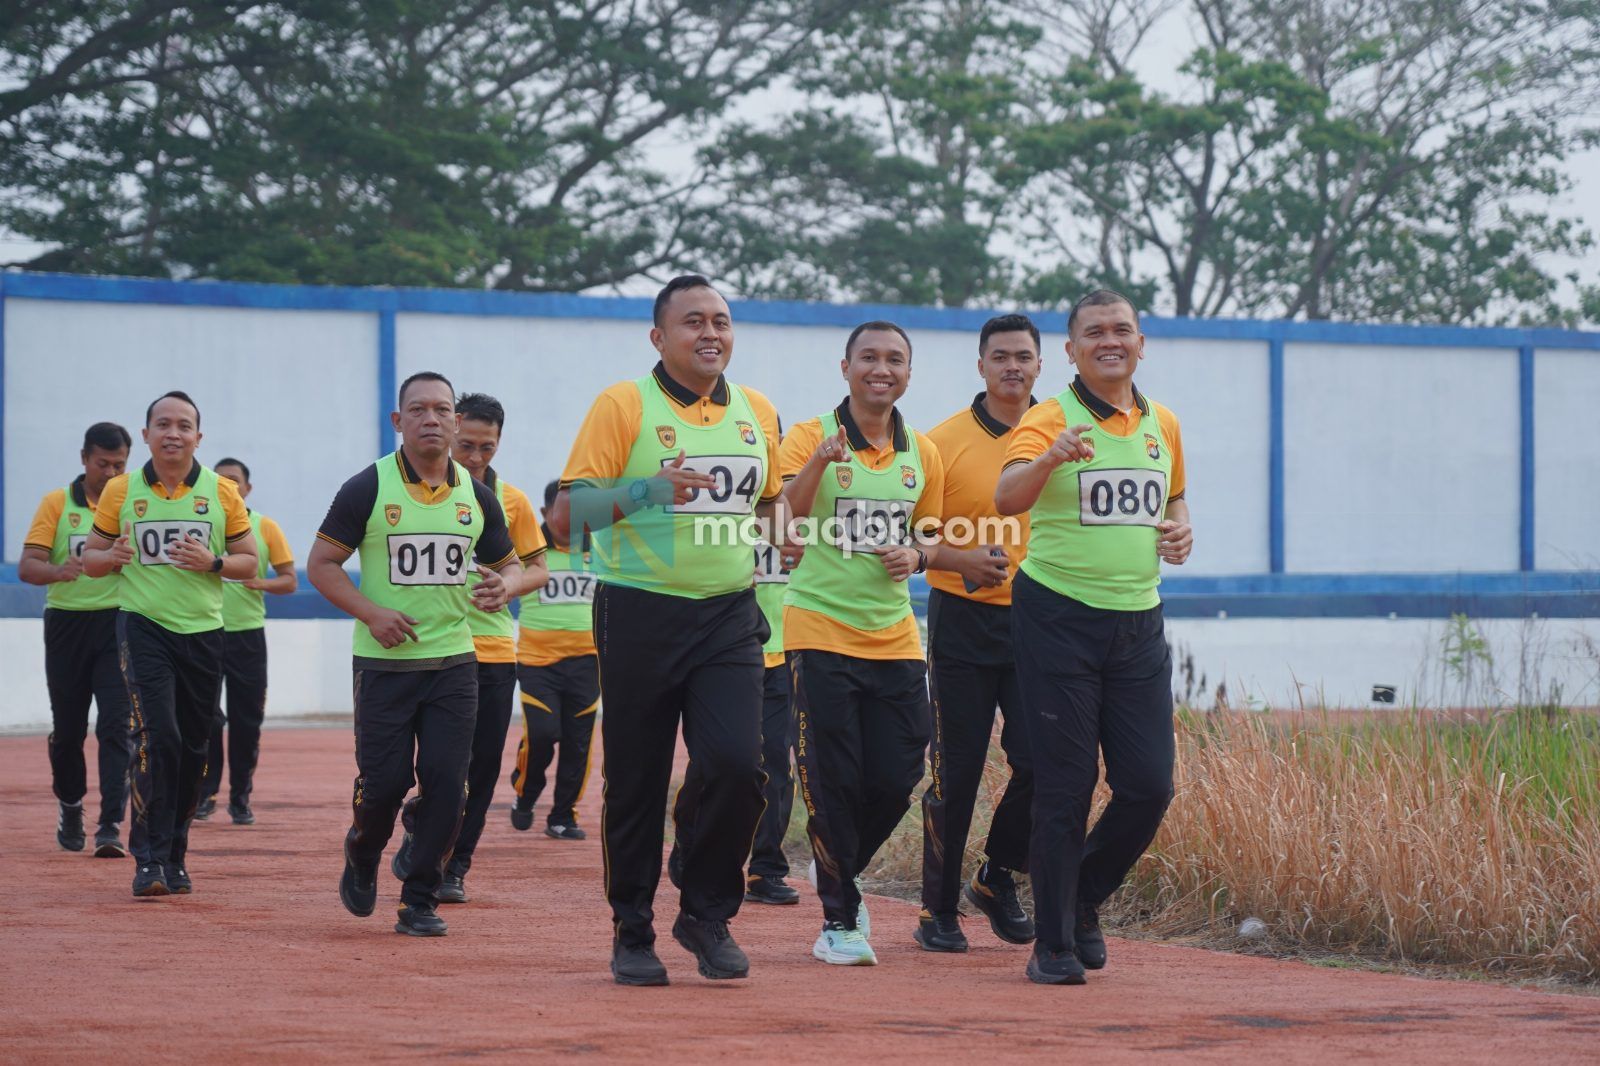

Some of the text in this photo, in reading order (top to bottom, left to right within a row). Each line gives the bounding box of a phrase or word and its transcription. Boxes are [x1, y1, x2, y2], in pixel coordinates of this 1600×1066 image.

[1090, 478, 1162, 517] 080
[397, 542, 464, 577] 019
[544, 576, 592, 599] 007
[799, 711, 807, 757] POLDA
